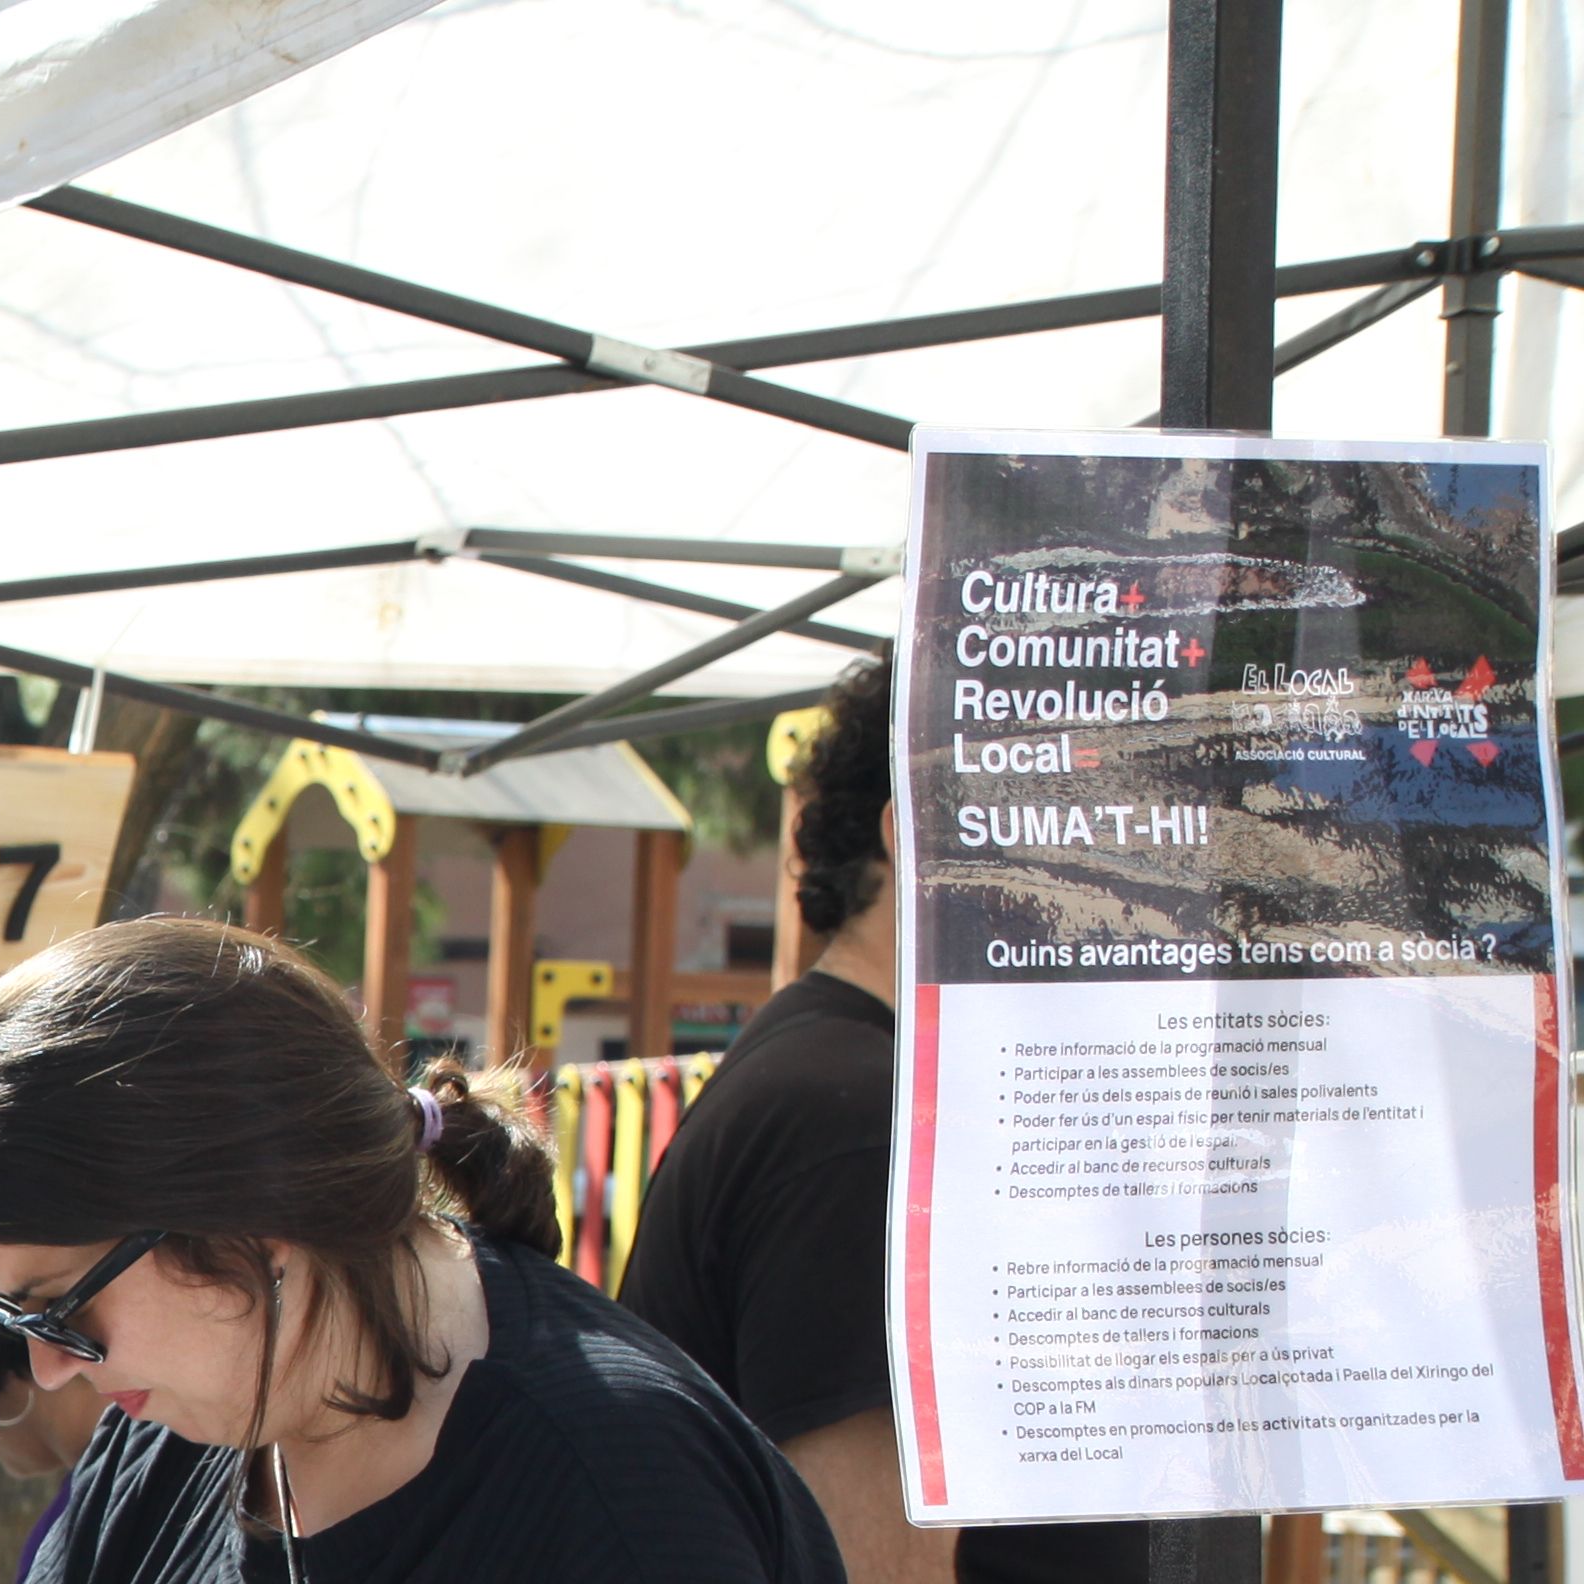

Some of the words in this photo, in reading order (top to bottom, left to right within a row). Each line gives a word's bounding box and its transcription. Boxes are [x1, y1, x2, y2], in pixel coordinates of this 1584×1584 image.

[954, 679, 1169, 721] Revolució
[1235, 748, 1304, 761] ASSOCIACIÓ
[1308, 750, 1365, 760] CULTURAL
[987, 939, 1072, 968] Quins
[1080, 939, 1231, 973] avantages
[1240, 935, 1303, 963] tens
[1310, 942, 1371, 963] com
[1379, 945, 1393, 961] a
[1158, 1013, 1188, 1030] Les
[1192, 1013, 1263, 1029] entitats
[1268, 1010, 1330, 1027] sòcies:
[1015, 1043, 1057, 1057] Rebre
[1060, 1042, 1135, 1054] informació
[1139, 1041, 1156, 1054] de
[1160, 1040, 1171, 1053] la
[1176, 1038, 1264, 1057] programació
[1267, 1038, 1327, 1052] mensual
[1014, 1067, 1083, 1083] Participar
[1087, 1069, 1095, 1079] a
[1098, 1066, 1118, 1078] les
[1122, 1064, 1206, 1078] assemblees
[1210, 1064, 1226, 1077] de
[1230, 1062, 1289, 1076] socis/es
[1014, 1091, 1055, 1104] Poder
[1060, 1090, 1078, 1103] fer
[1082, 1091, 1098, 1103] ús
[1102, 1089, 1132, 1102] dels
[1135, 1089, 1181, 1104] espais
[1185, 1088, 1202, 1100] de
[1206, 1085, 1250, 1100] reunió
[1261, 1085, 1298, 1099] sales
[1301, 1084, 1378, 1101] polivalents
[1013, 1115, 1055, 1128] Poder
[1059, 1114, 1078, 1127] fer
[1082, 1115, 1098, 1127] ús
[1102, 1113, 1133, 1126] d'un
[1136, 1113, 1174, 1128] espai
[1211, 1112, 1235, 1128] per
[1238, 1110, 1268, 1122] tenir
[1273, 1108, 1339, 1122] materials
[1342, 1108, 1359, 1120] de
[1012, 1138, 1081, 1155] participar
[1084, 1139, 1102, 1149] en
[1105, 1136, 1117, 1149] la
[1120, 1135, 1165, 1152] gestió
[1169, 1134, 1186, 1148] de
[1010, 1162, 1064, 1175] Accedir
[1068, 1161, 1079, 1173] al
[1083, 1160, 1119, 1173] banc
[1122, 1159, 1139, 1172] de
[1142, 1158, 1205, 1171] recursos
[1208, 1157, 1271, 1171] culturals
[1009, 1186, 1099, 1200] Descomptes
[1102, 1184, 1120, 1196] de
[1123, 1182, 1168, 1196] tallers
[1179, 1181, 1257, 1194] formacions
[1145, 1232, 1175, 1247] Les
[1180, 1231, 1263, 1252] persones
[1268, 1226, 1331, 1243] sòcies:
[1007, 1262, 1049, 1275] Rebre
[1053, 1258, 1130, 1273] informació
[1133, 1258, 1150, 1271] de
[1155, 1258, 1167, 1271] la
[1169, 1254, 1260, 1274] programació
[1263, 1254, 1323, 1268] mensual
[1007, 1286, 1076, 1301] Participar
[1081, 1286, 1089, 1297] a
[1093, 1284, 1113, 1296] les
[1117, 1282, 1202, 1295] assemblees
[1206, 1281, 1223, 1293] de
[1227, 1279, 1286, 1293] socis/es
[1008, 1309, 1063, 1322] Accedir
[1066, 1308, 1077, 1320] al
[1082, 1306, 1117, 1320] banc
[1120, 1306, 1138, 1319] de
[1141, 1305, 1204, 1318] recursos
[1207, 1301, 1270, 1317] culturals
[1008, 1332, 1099, 1348] Descomptes
[1102, 1330, 1121, 1343] de
[1124, 1329, 1169, 1342] tallers
[1179, 1326, 1259, 1341] formacions
[1010, 1354, 1091, 1369] Possibilitat
[1094, 1354, 1112, 1366] de
[1116, 1352, 1156, 1369] llogar
[1159, 1351, 1180, 1364] els
[1183, 1350, 1228, 1366] espais
[1232, 1348, 1255, 1365] per
[1260, 1350, 1268, 1360] a
[1272, 1347, 1289, 1360] ús
[1293, 1346, 1334, 1363] privat
[1012, 1379, 1102, 1394] Descomptes
[1105, 1377, 1125, 1390] als
[1128, 1375, 1173, 1389] dinars
[1176, 1374, 1238, 1390] populars
[1241, 1368, 1333, 1387] Localçotada
[1343, 1367, 1387, 1381] Paella
[1391, 1366, 1412, 1379] del
[1416, 1365, 1468, 1381] Xiringo
[1472, 1363, 1493, 1376] del
[1014, 1402, 1045, 1416] COP
[1049, 1405, 1057, 1414] a
[1060, 1401, 1072, 1414] la
[1076, 1401, 1096, 1413] FM
[1016, 1425, 1106, 1441] Descomptes
[1109, 1426, 1127, 1436] en
[1130, 1420, 1213, 1438] promocions
[1217, 1419, 1234, 1433] de
[1237, 1418, 1259, 1431] les
[1262, 1415, 1336, 1430] activitats
[1340, 1411, 1436, 1430] organitzades
[1439, 1411, 1464, 1427] per
[1467, 1410, 1479, 1422] la
[1019, 1450, 1057, 1462] xarxa
[1061, 1448, 1082, 1461] del
[1085, 1446, 1123, 1460] Local
